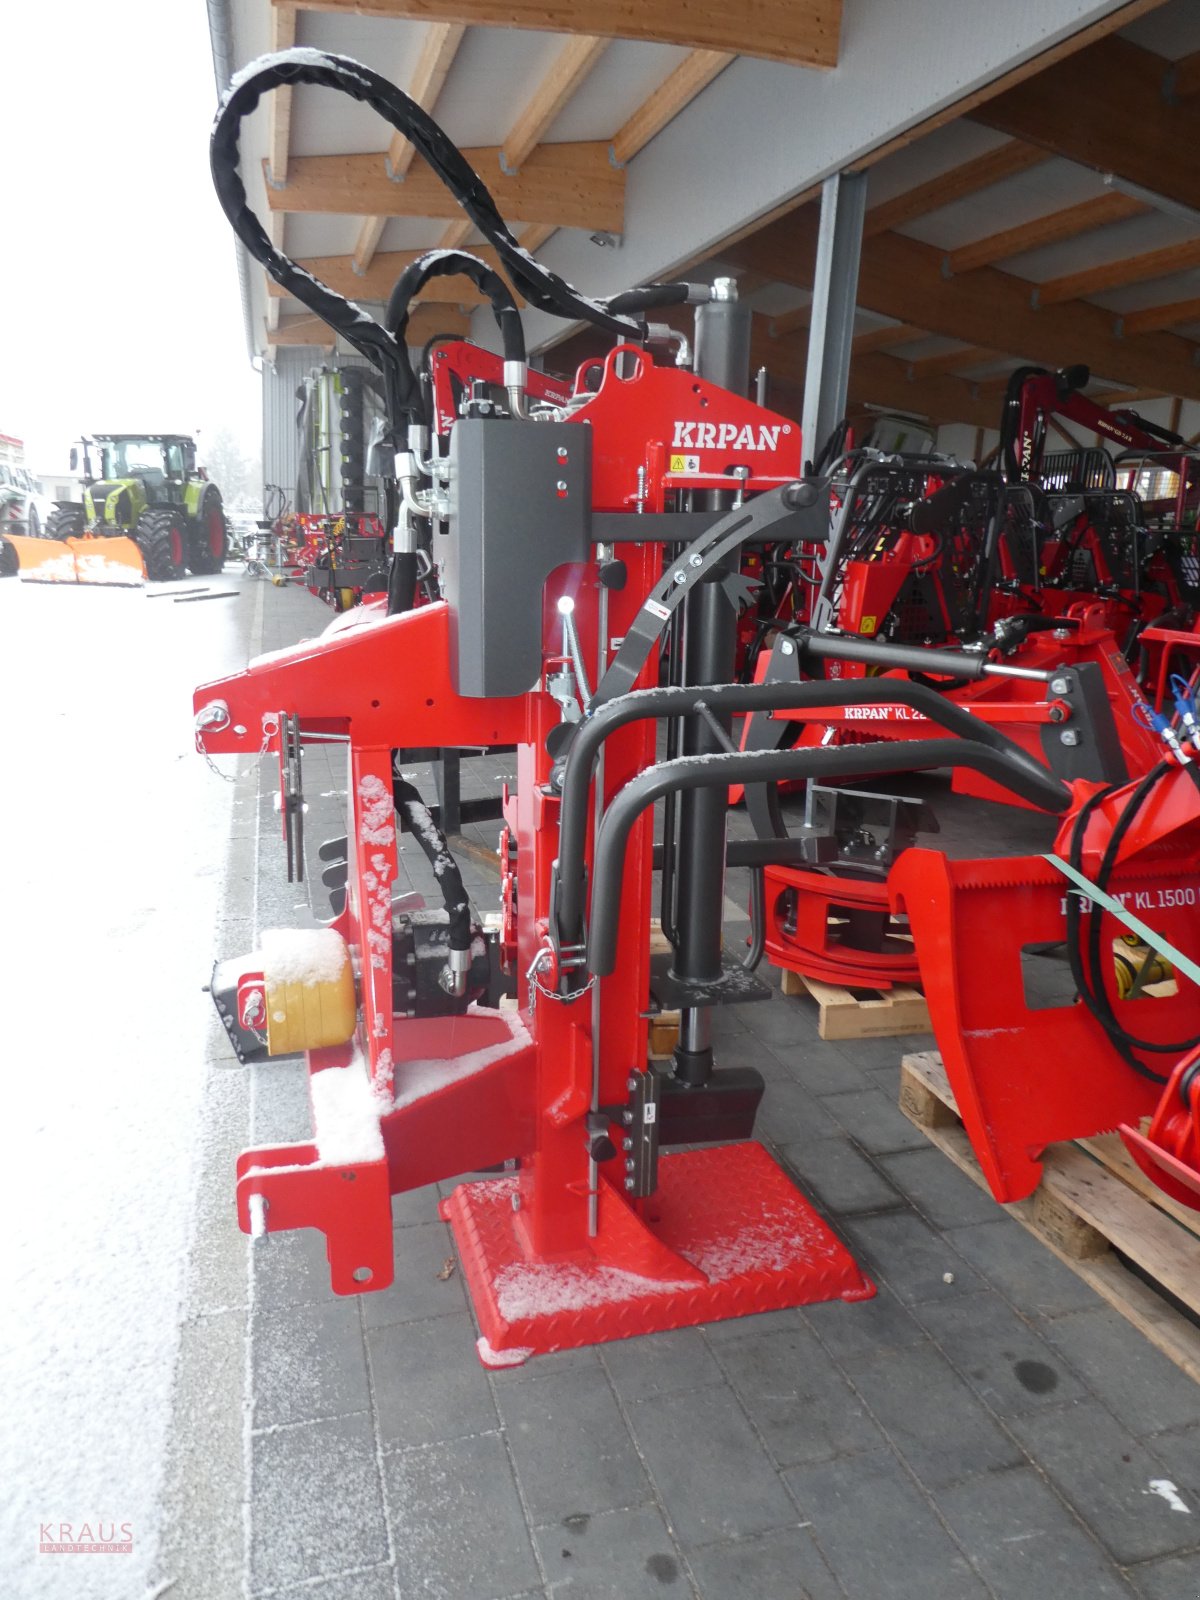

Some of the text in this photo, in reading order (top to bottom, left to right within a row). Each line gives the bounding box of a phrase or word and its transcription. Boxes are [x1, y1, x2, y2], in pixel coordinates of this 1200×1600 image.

[895, 708, 910, 720] KL
[1135, 892, 1156, 910] KL
[1157, 888, 1196, 909] 1500
